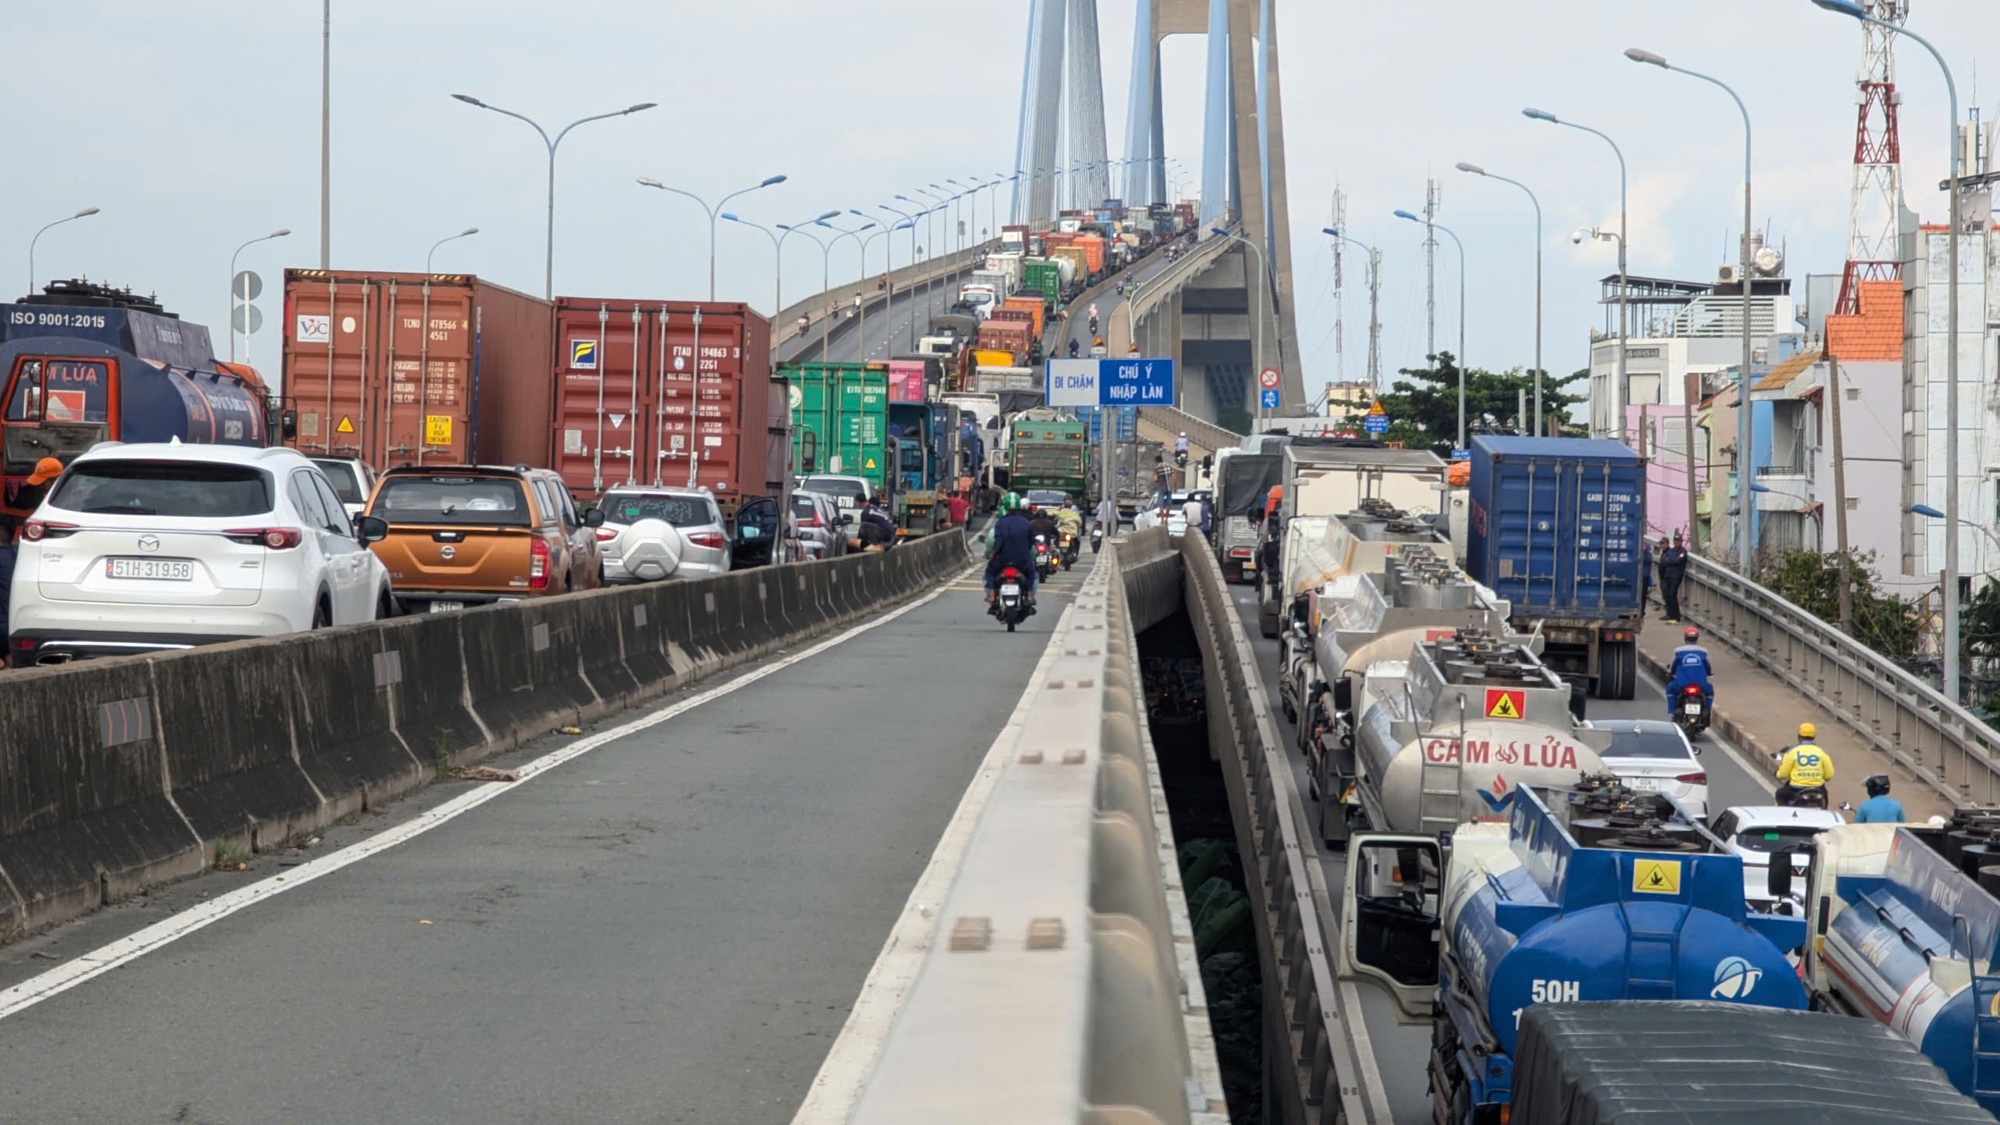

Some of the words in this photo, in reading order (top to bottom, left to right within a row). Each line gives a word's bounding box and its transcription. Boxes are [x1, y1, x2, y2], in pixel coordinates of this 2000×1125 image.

[10, 311, 35, 325] ISO
[39, 313, 105, 328] 9001:2015
[403, 318, 421, 329] TCNU
[429, 319, 457, 330] 478566
[429, 331, 448, 341] 45G1
[673, 346, 692, 357] FTAU
[700, 347, 727, 358] 194863
[1118, 363, 1139, 379] CHÚ
[1145, 362, 1153, 379] Ý
[1054, 376, 1063, 389] ĐI
[1067, 374, 1094, 391] CHẬM
[1109, 383, 1138, 401] NHẬP
[1142, 382, 1163, 399] LÀN
[114, 561, 190, 578] 51H-319.58
[1523, 735, 1577, 770] LỬA
[1796, 750, 1820, 768] be
[1531, 979, 1580, 1003] 50H
